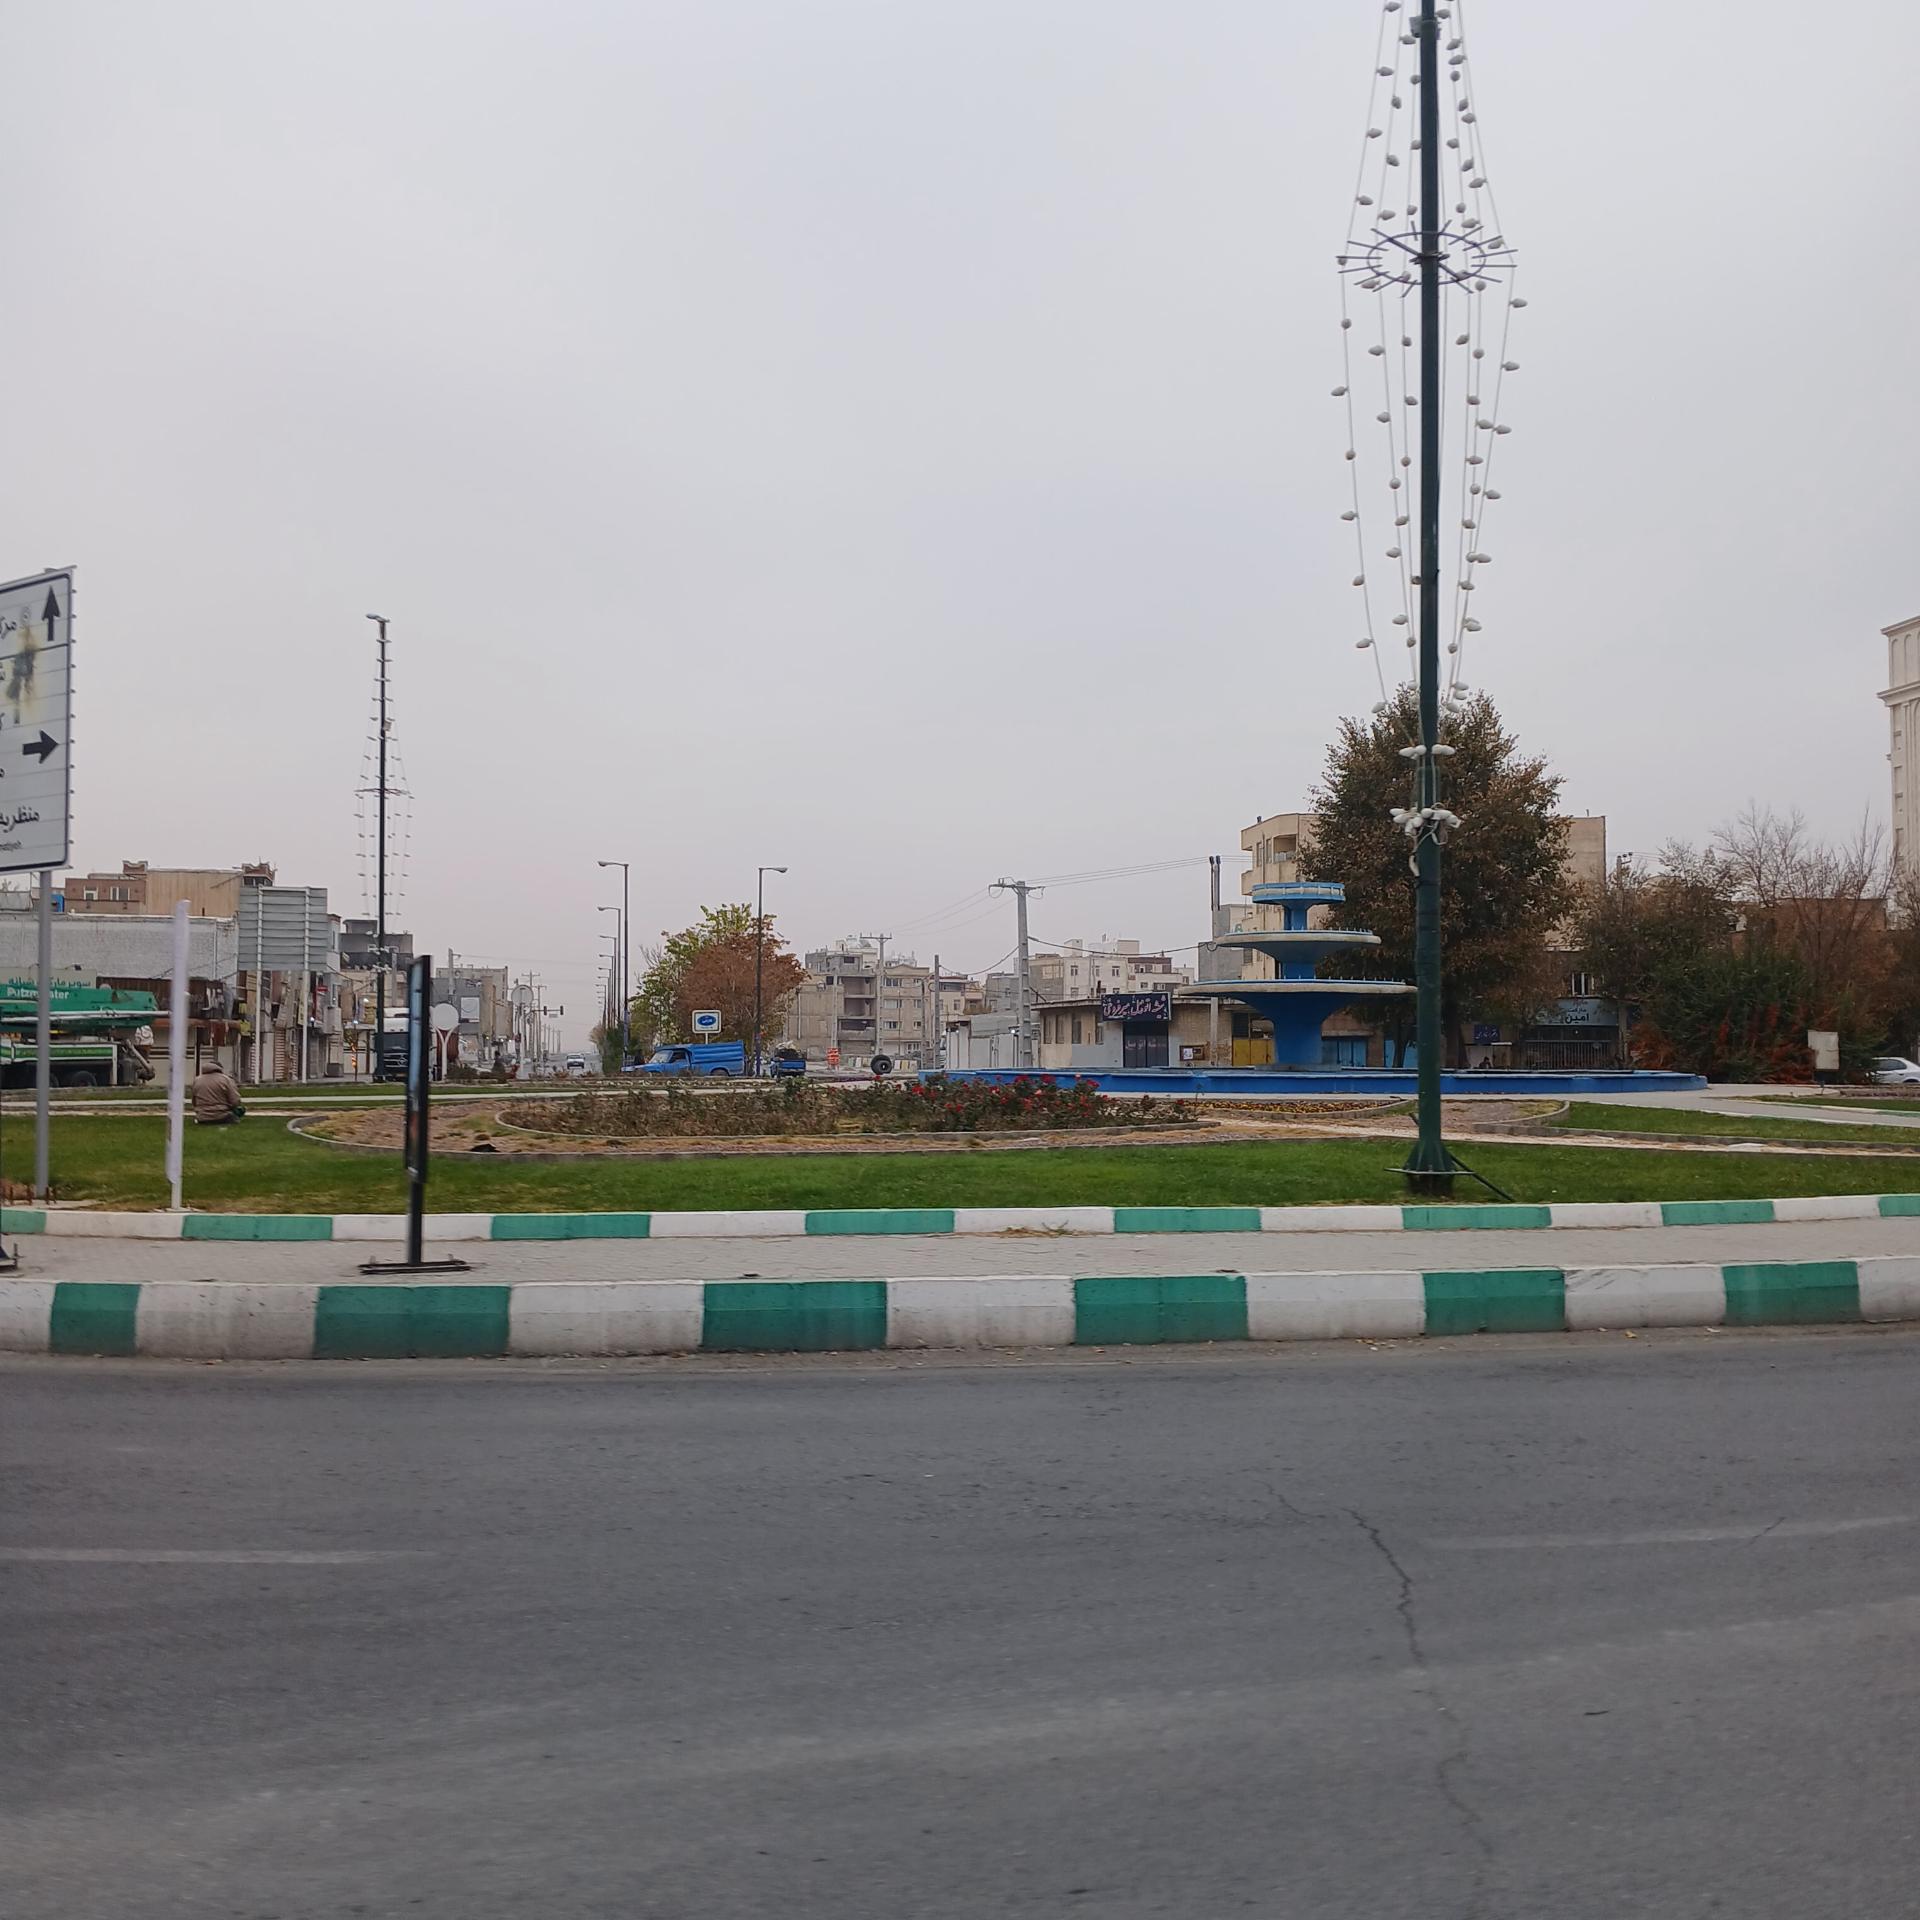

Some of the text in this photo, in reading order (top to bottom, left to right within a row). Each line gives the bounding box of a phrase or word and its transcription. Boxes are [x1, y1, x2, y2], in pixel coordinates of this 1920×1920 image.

[0, 806, 40, 833] منظری
[7, 987, 70, 1000] Putzmster
[1565, 1013, 1589, 1024] امین
